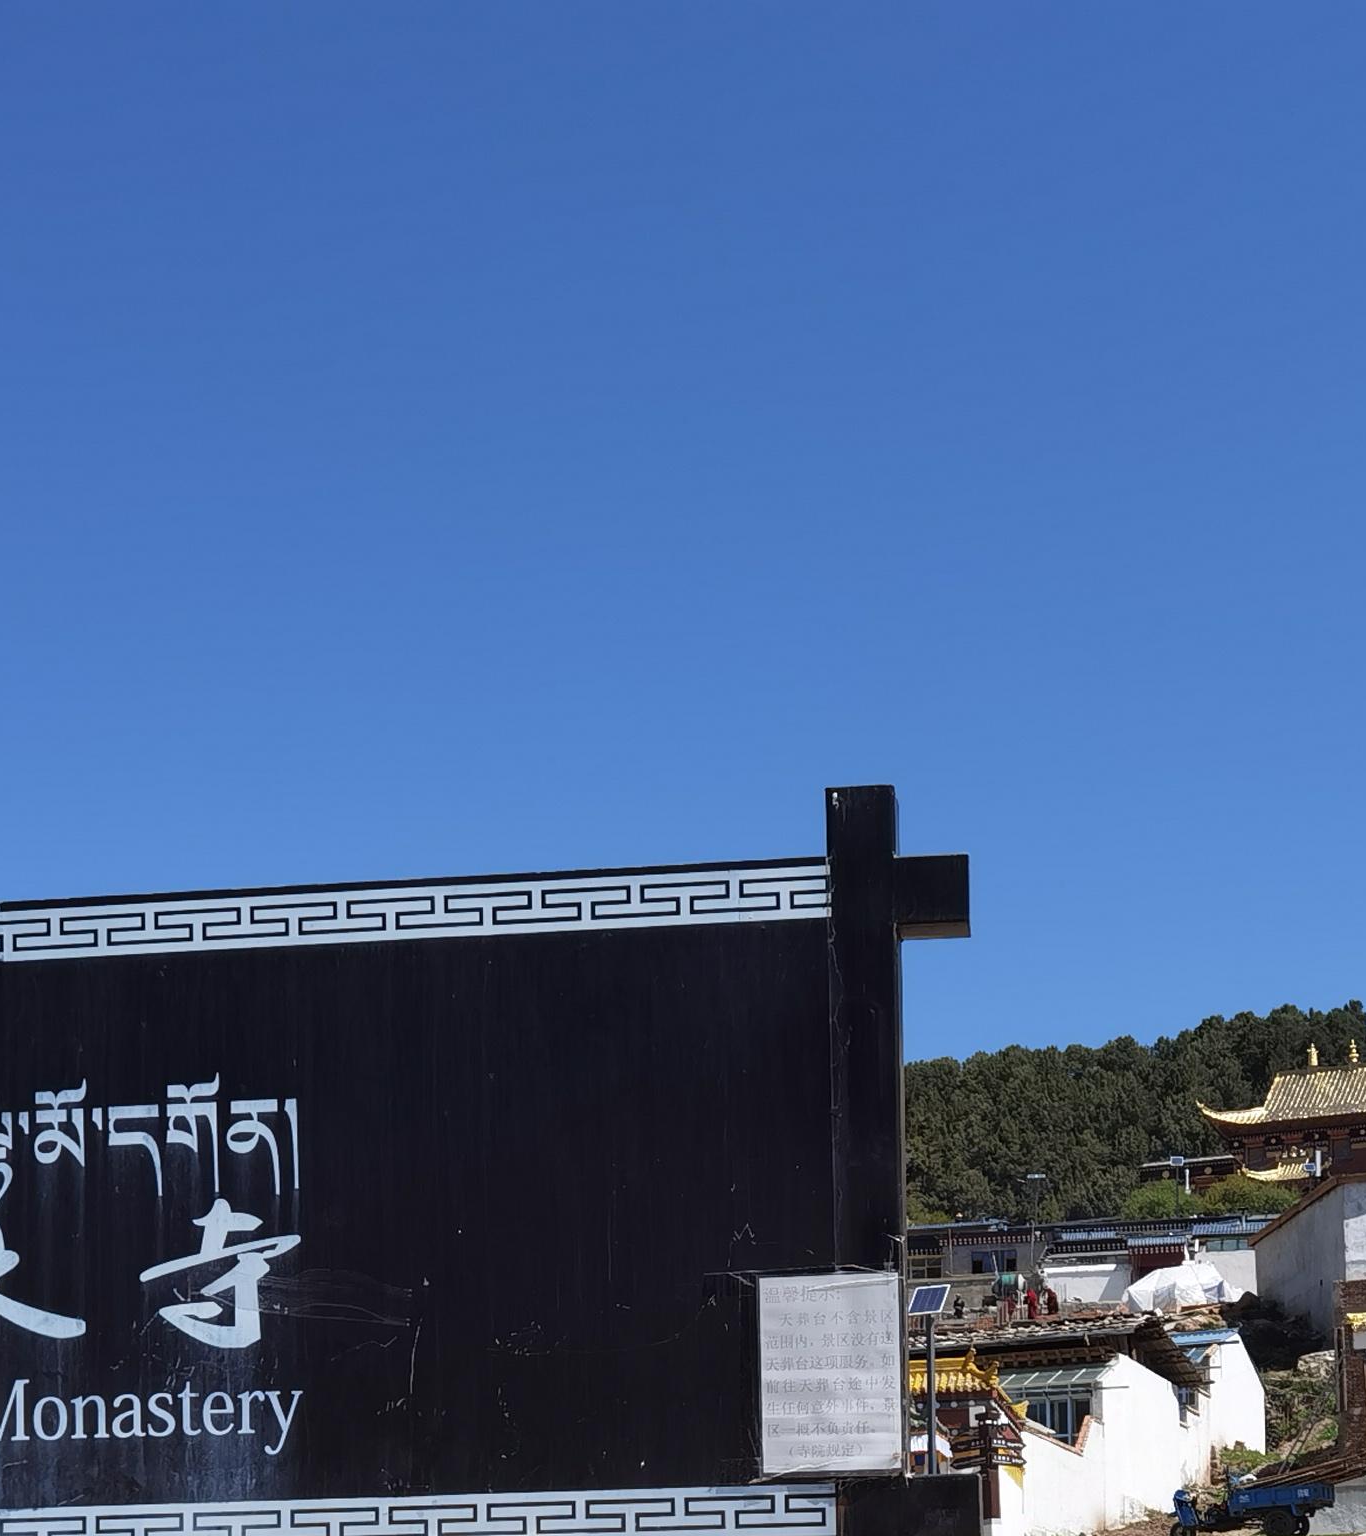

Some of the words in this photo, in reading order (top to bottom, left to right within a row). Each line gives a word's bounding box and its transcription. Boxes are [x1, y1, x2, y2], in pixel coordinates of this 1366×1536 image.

[779, 1309, 894, 1327] 天葬台不含景区
[766, 1375, 895, 1394] 前往天葬台途中发
